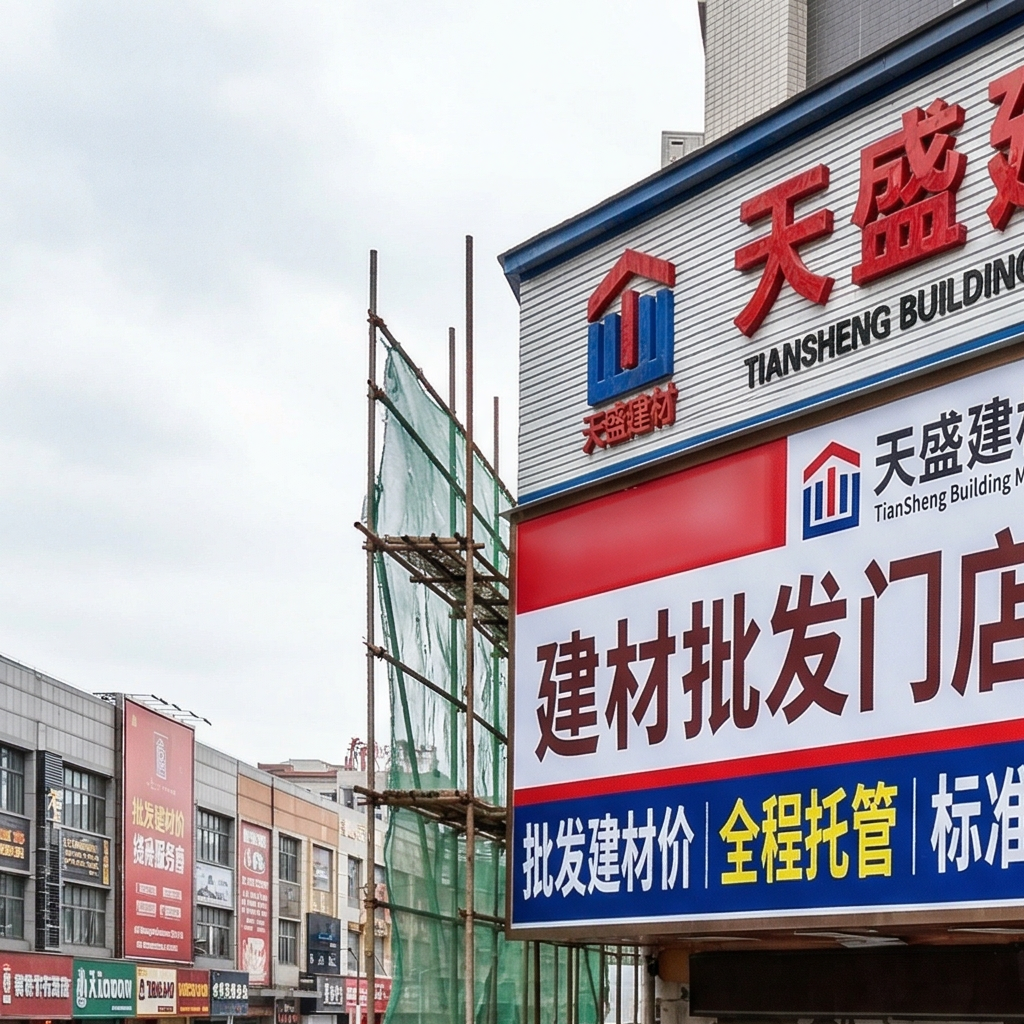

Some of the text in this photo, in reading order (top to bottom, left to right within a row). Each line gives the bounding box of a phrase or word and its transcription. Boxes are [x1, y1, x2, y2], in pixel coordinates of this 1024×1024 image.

[744, 305, 891, 389] TIANSHENG
[582, 381, 679, 455] 天盛建材
[874, 491, 947, 522] TianSheng
[950, 473, 1011, 503] Building
[522, 804, 695, 900] 批发建材价
[718, 781, 898, 885] 全程托管
